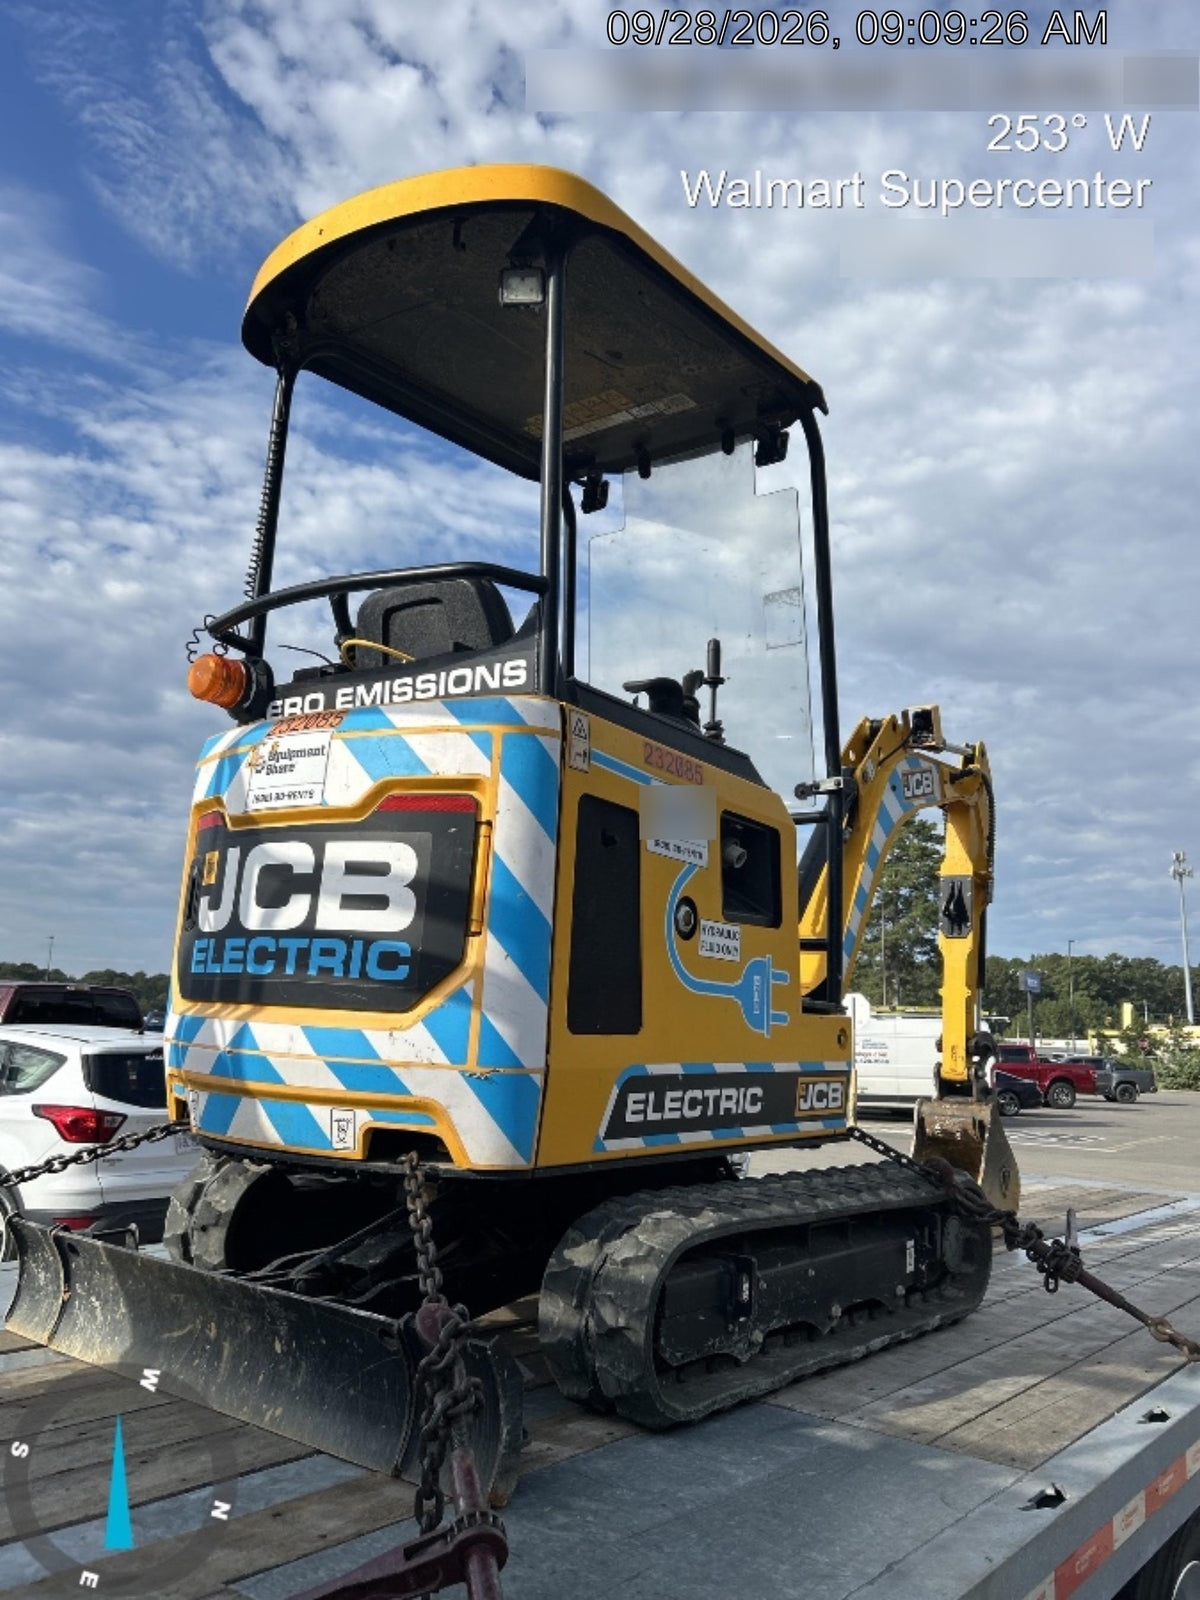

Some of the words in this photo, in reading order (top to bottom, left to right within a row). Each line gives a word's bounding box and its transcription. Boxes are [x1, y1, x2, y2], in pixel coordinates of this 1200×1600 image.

[335, 658, 527, 710] EMISSIONS
[643, 741, 704, 786] 232085
[904, 771, 932, 797] JCB
[198, 841, 418, 932] JCB
[190, 937, 412, 981] ELECTRIC
[625, 1087, 764, 1123] ELECTRIC
[799, 1083, 844, 1110] JCB
